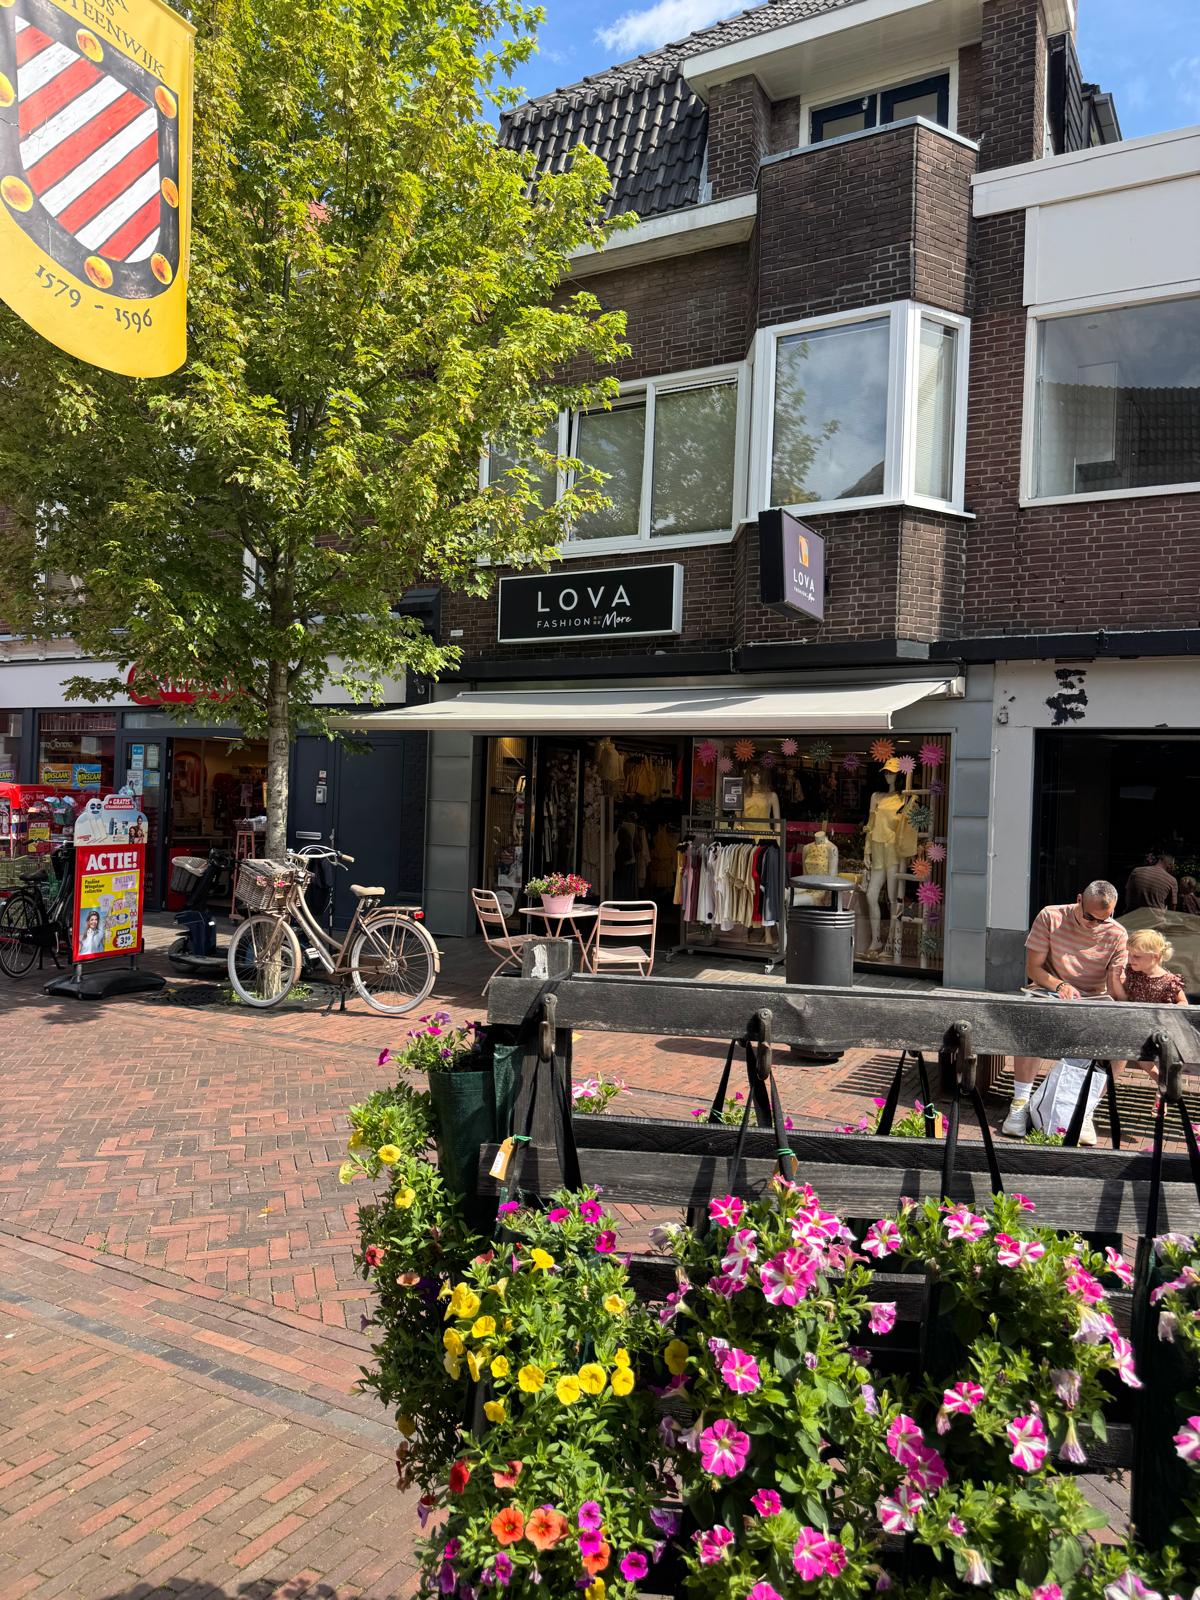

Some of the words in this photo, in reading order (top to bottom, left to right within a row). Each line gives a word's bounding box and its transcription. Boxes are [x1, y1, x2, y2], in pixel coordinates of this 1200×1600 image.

[35, 264, 82, 308] 1579
[114, 308, 153, 333] 1596
[793, 568, 815, 592] LOVA
[537, 585, 631, 612] LOVA
[536, 617, 591, 629] FASHION
[601, 611, 632, 628] More
[85, 851, 138, 871] ACTIE!
